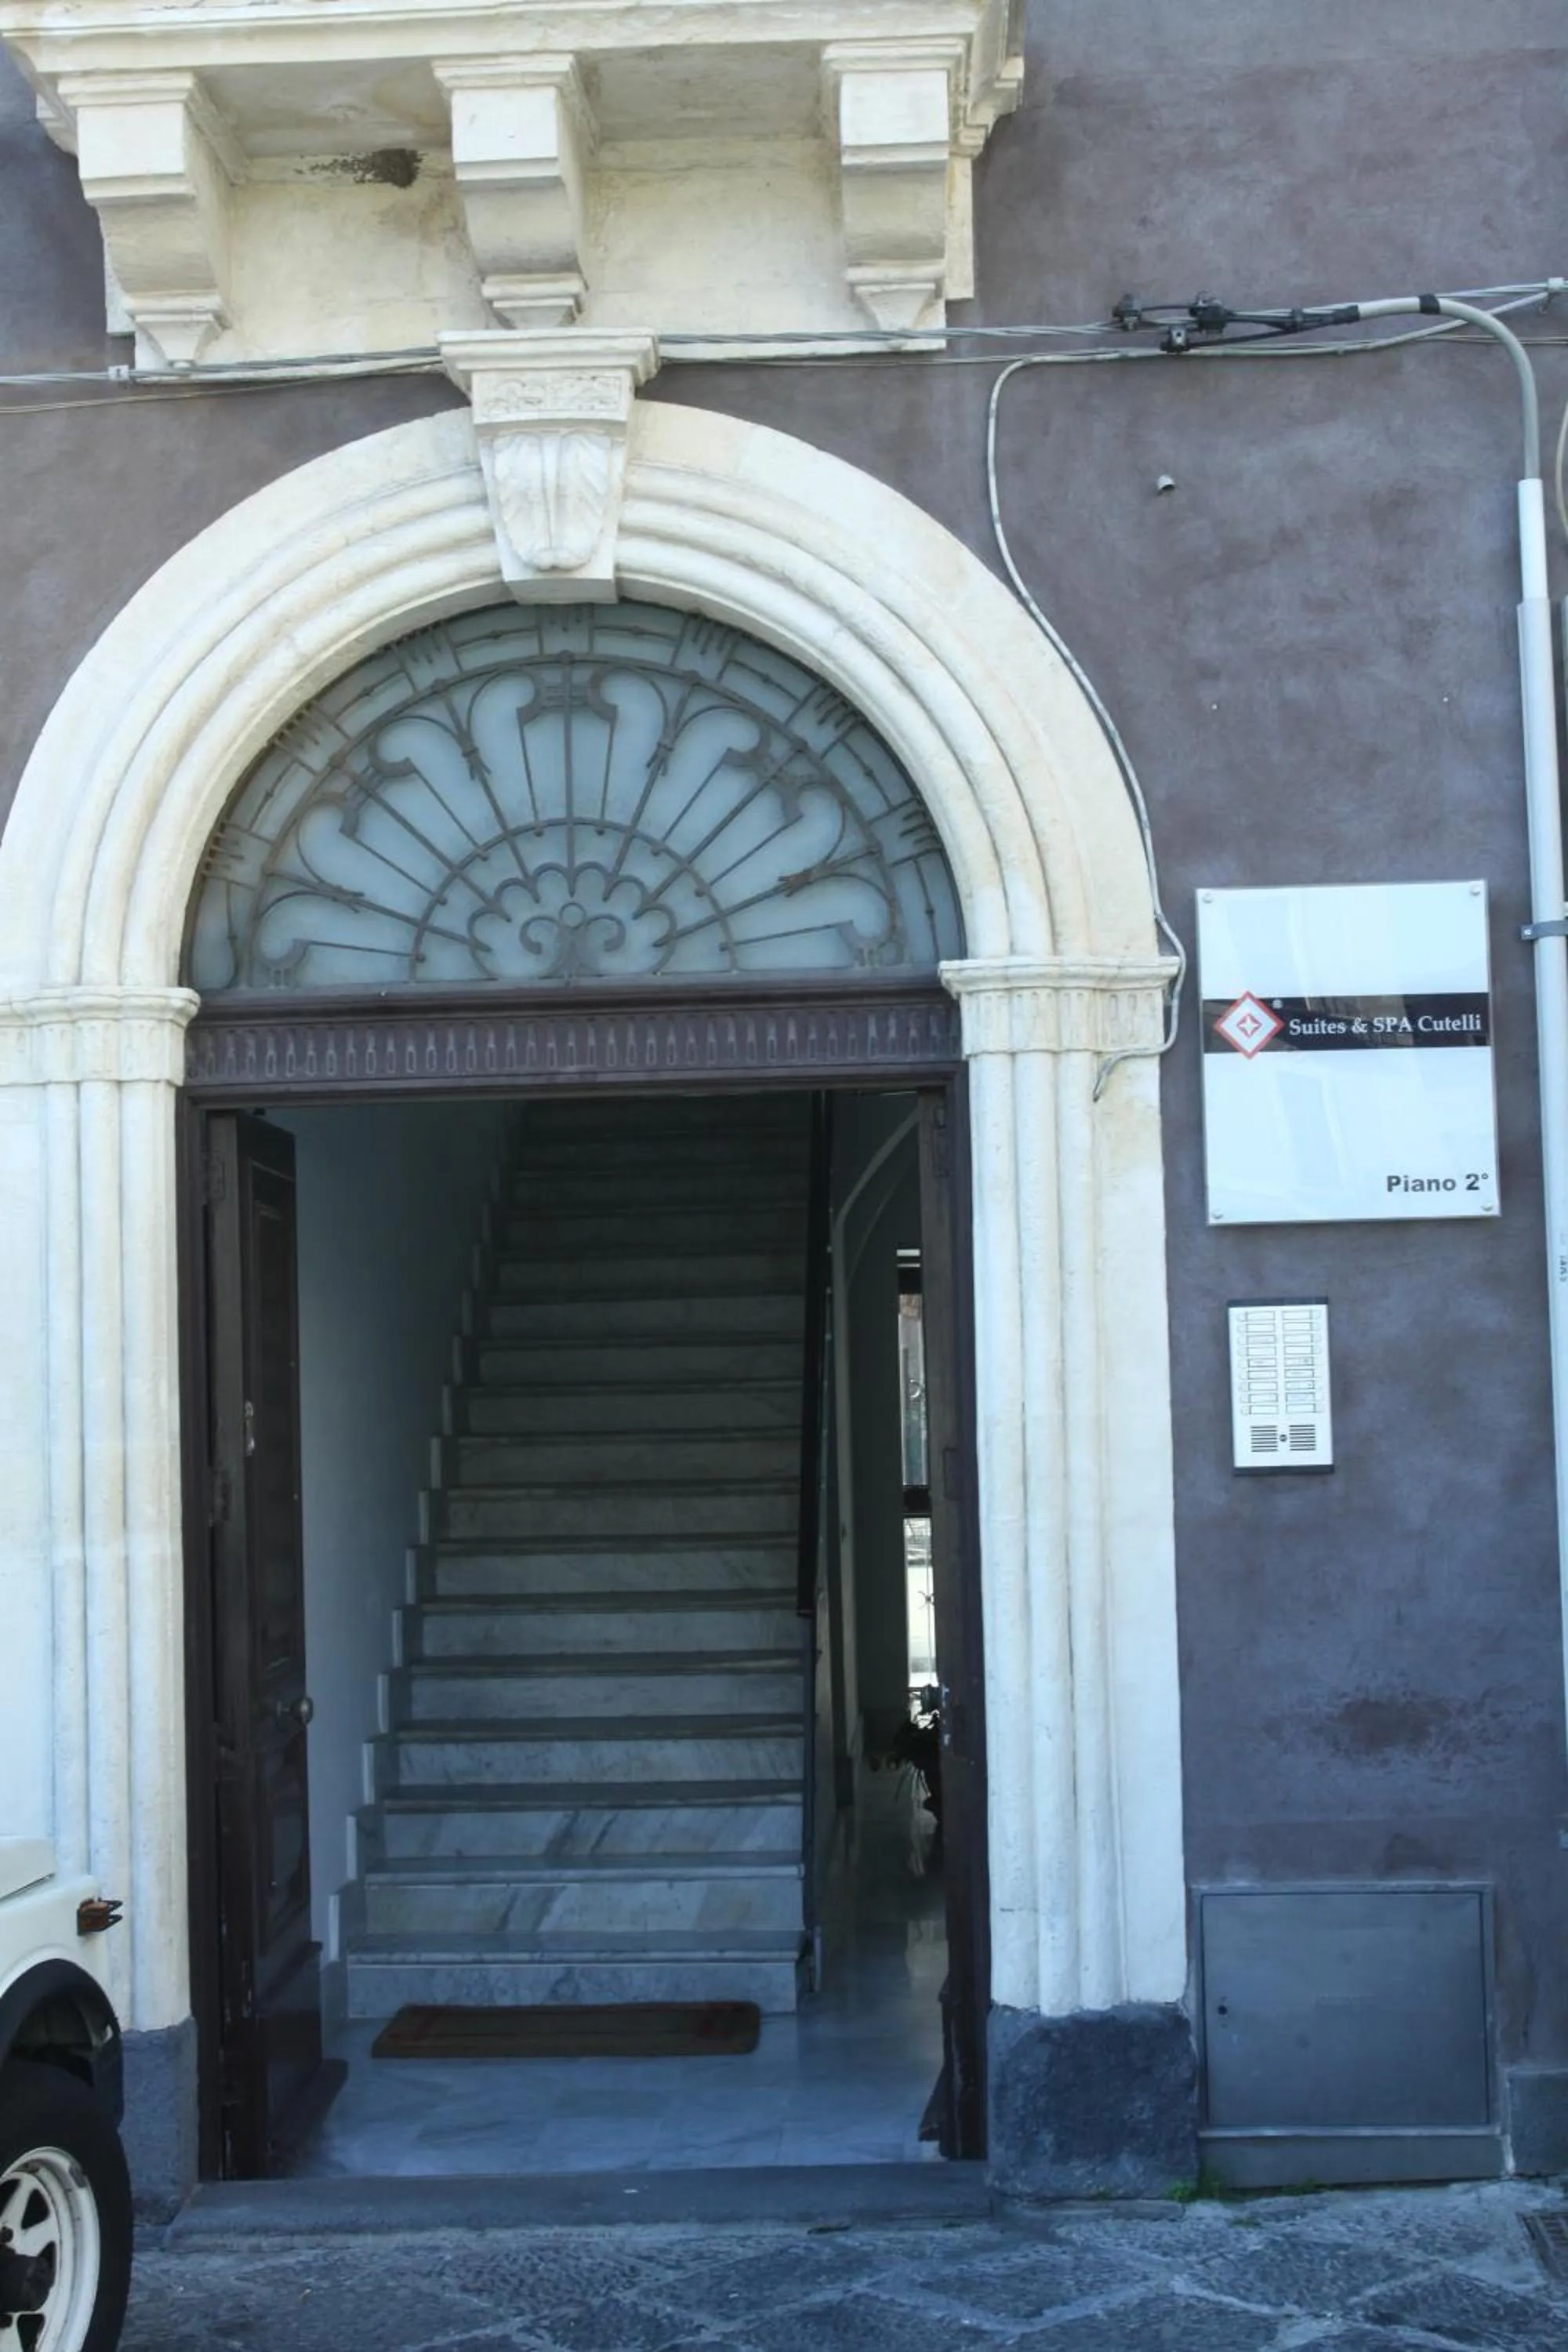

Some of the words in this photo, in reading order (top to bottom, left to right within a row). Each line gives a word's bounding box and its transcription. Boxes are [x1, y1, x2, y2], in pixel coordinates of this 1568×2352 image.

[1289, 1018, 1346, 1035] Suites
[1352, 1017, 1368, 1033] &
[1373, 1016, 1412, 1033] SPA
[1417, 1014, 1481, 1032] Cutelli
[1386, 1175, 1456, 1192] Piano
[1465, 1173, 1489, 1191] 2°
